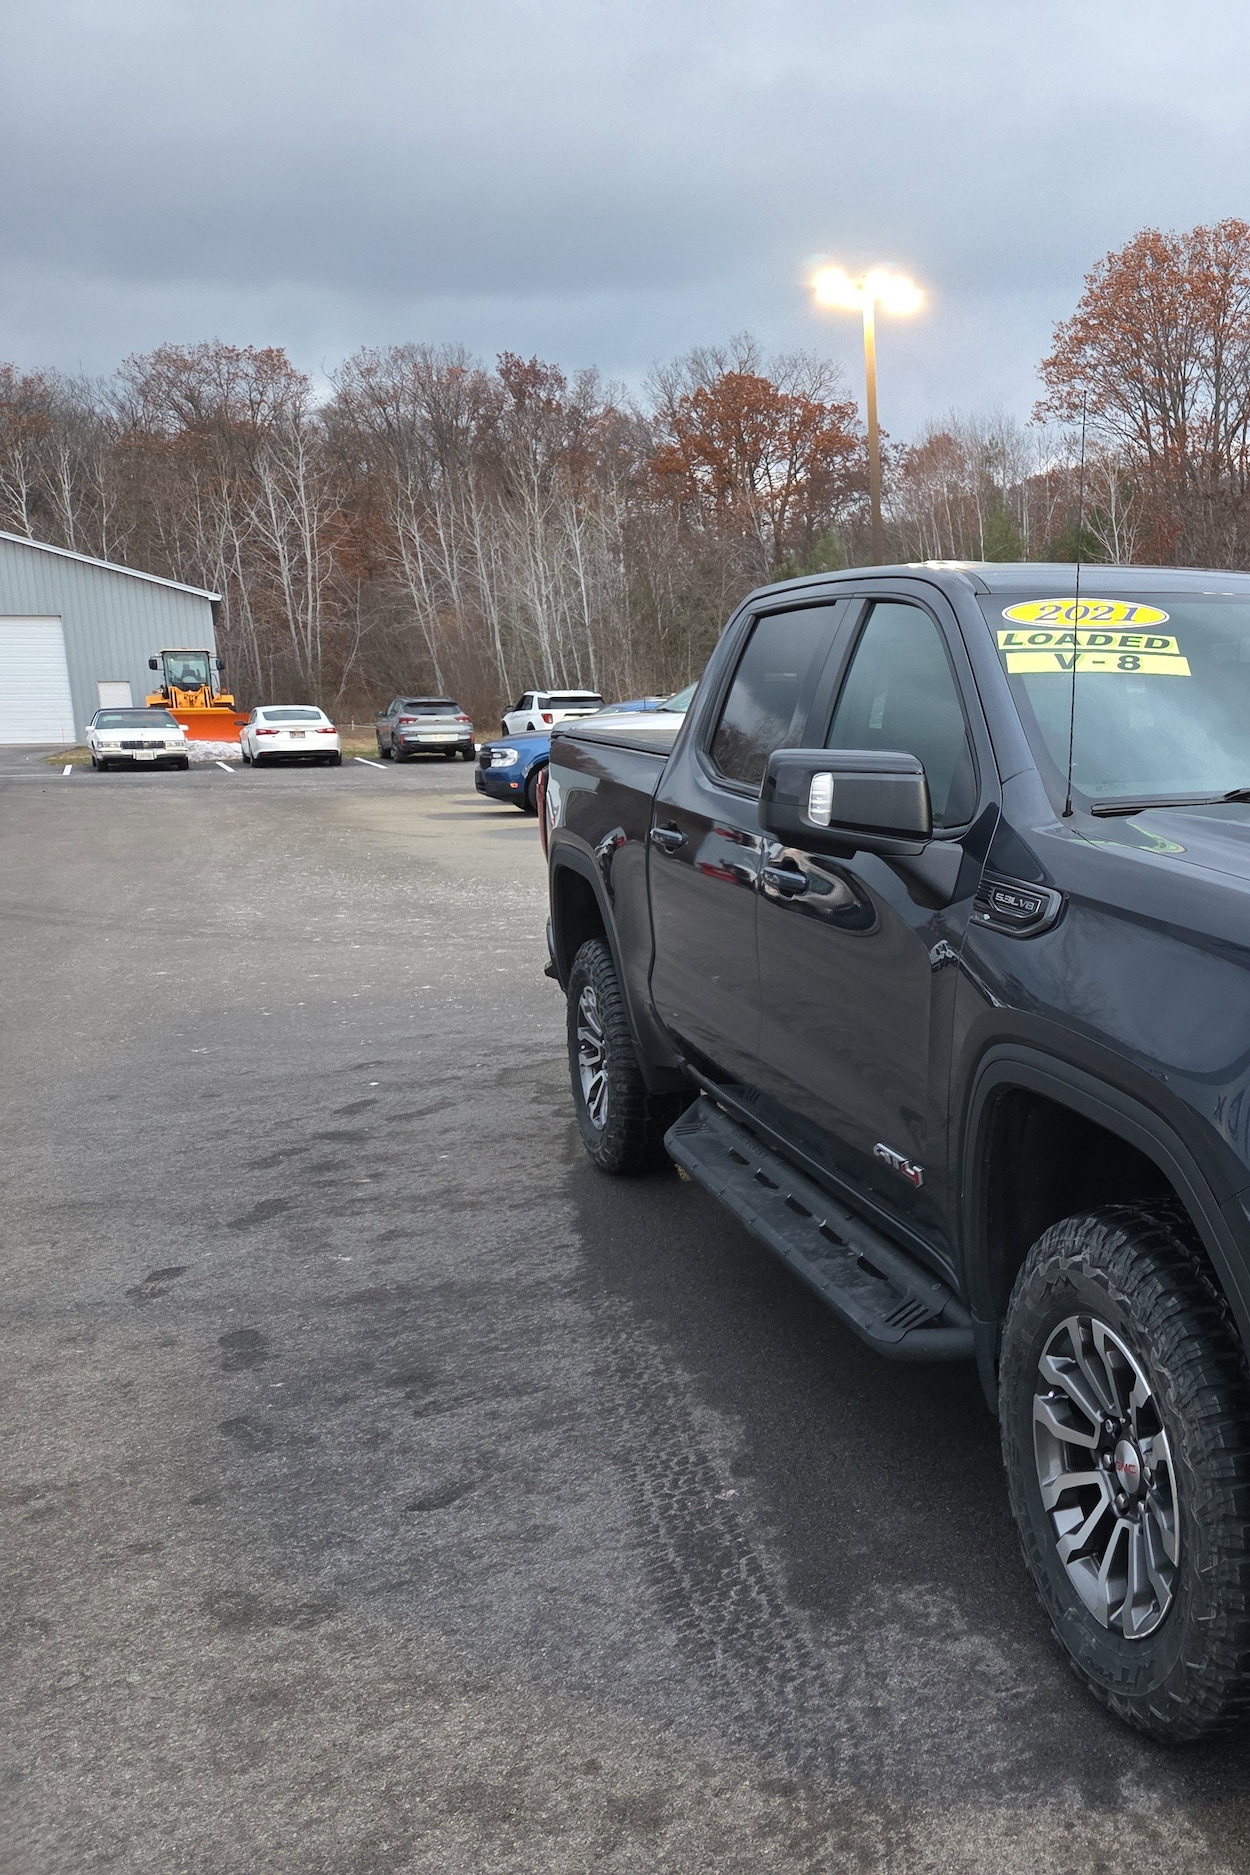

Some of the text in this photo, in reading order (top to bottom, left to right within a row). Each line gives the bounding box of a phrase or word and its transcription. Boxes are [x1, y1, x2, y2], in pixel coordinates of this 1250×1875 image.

[1035, 605, 1138, 621] 2021
[1003, 633, 1170, 649] LOADED
[1054, 653, 1141, 671] V-8
[873, 1142, 924, 1188] AT4
